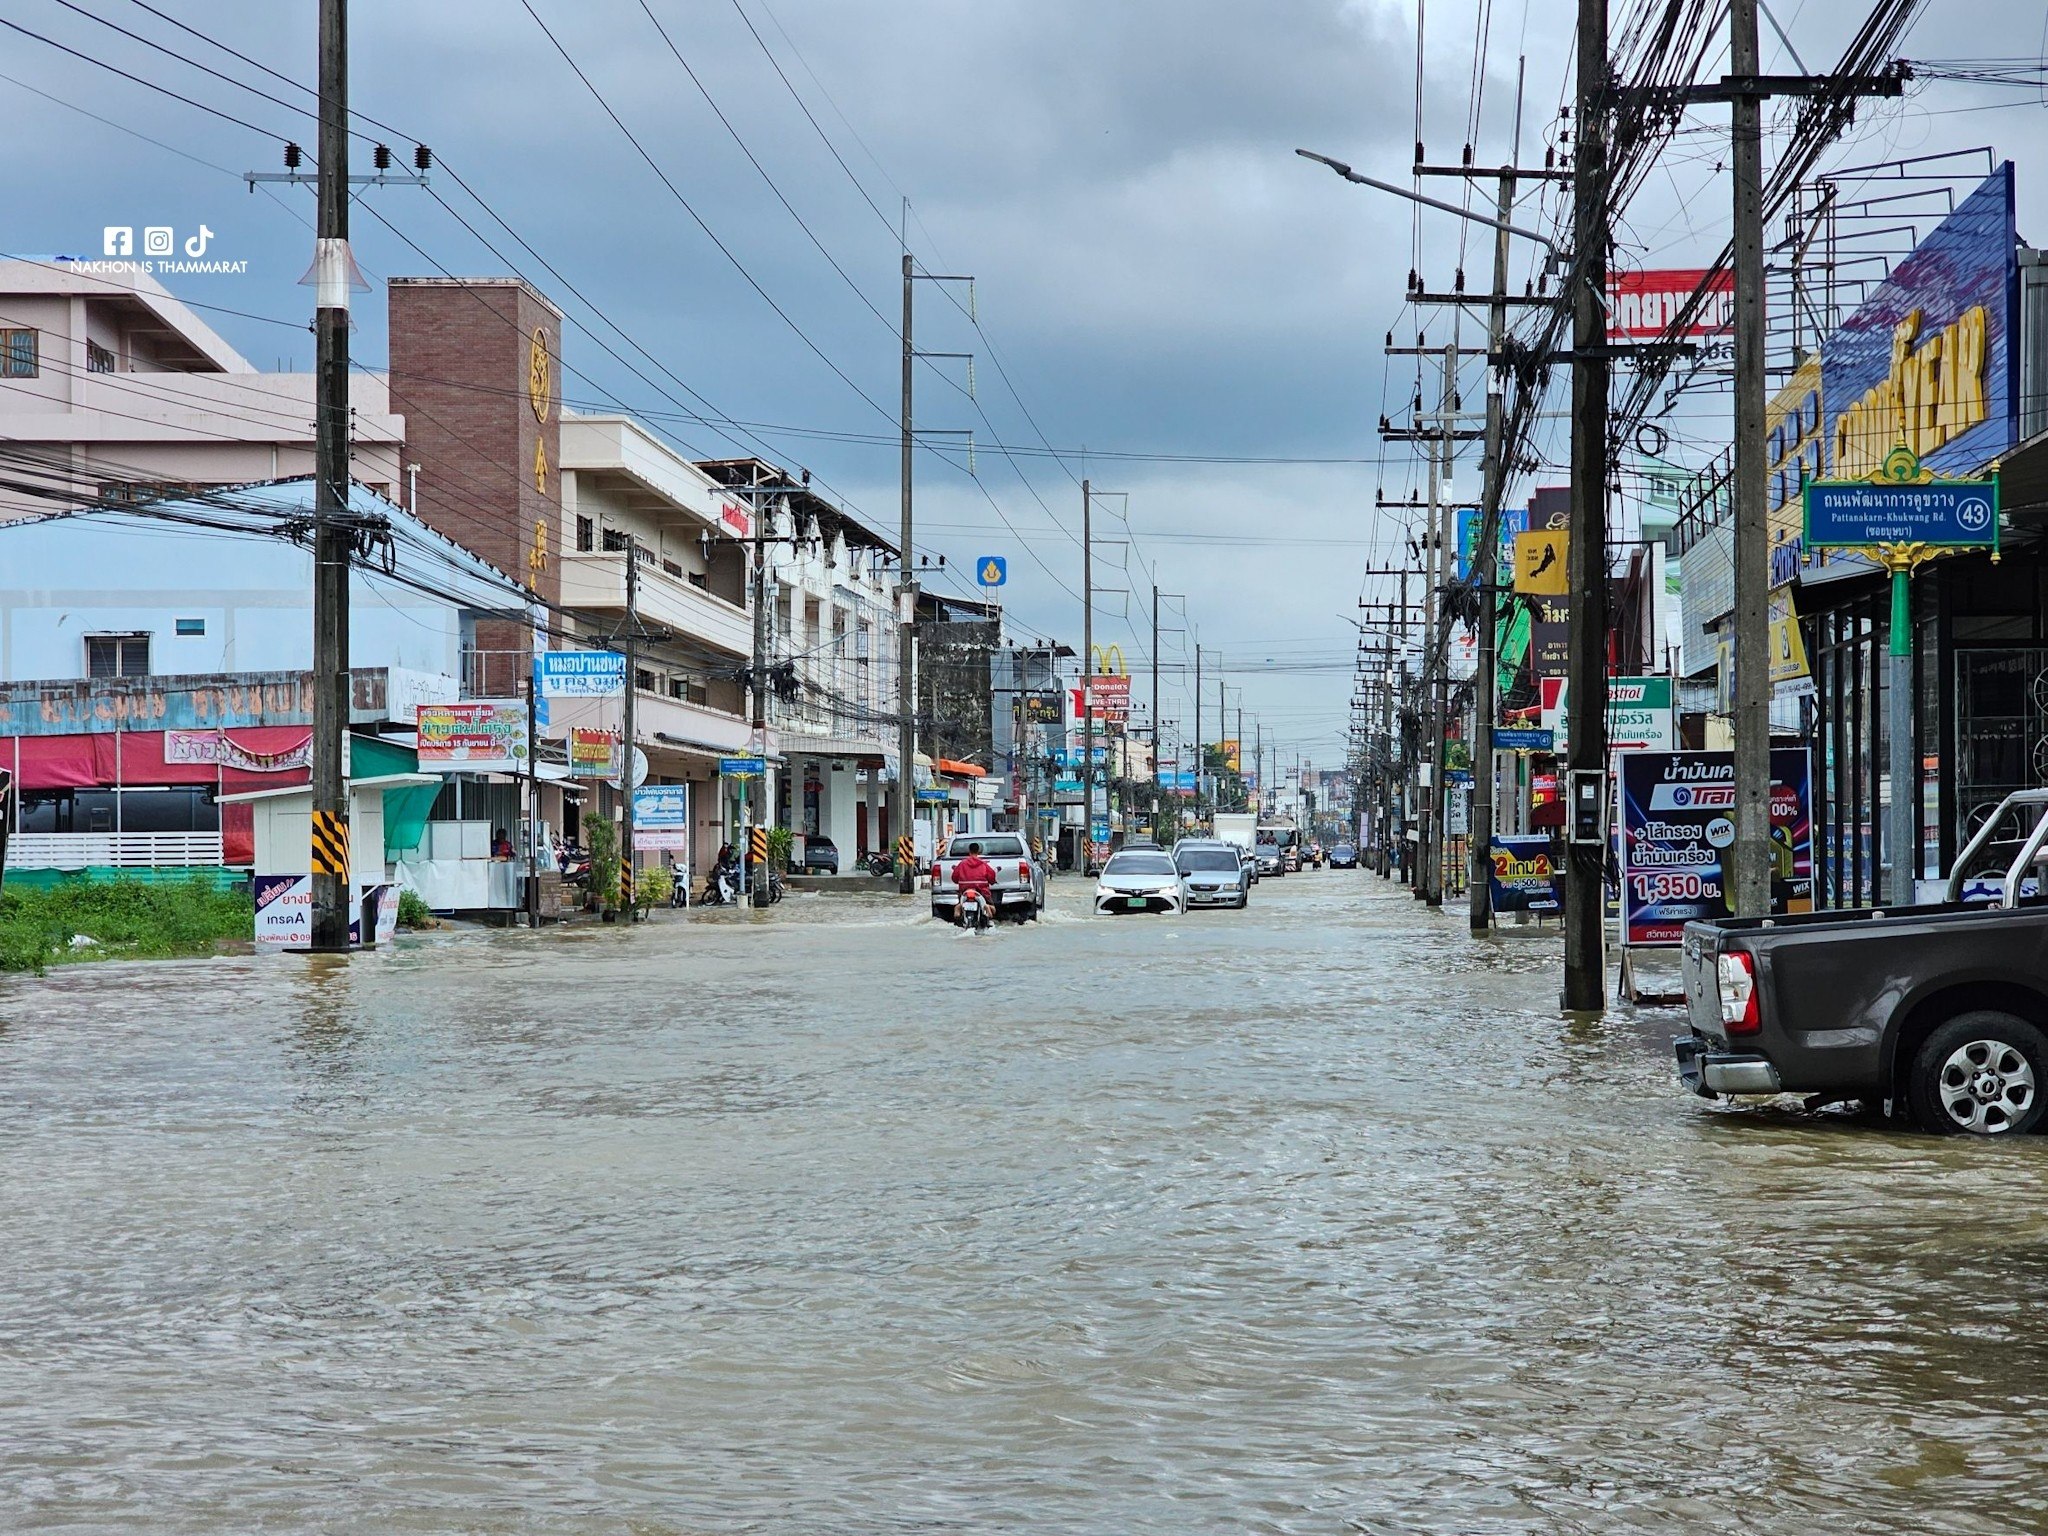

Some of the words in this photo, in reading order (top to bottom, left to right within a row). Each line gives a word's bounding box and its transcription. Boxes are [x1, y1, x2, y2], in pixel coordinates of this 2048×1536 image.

[1824, 490, 1955, 512] ถนนพัฒนาการคูขวาง
[1962, 504, 1985, 524] 43
[1831, 513, 1930, 523] Pattanakarn-Khukwang
[1933, 513, 1947, 522] Rd.
[1608, 686, 1641, 699] astrol
[1664, 757, 1735, 780] น้ำมันเค
[1691, 787, 1735, 804] Tran
[1771, 803, 1798, 817] 00%
[1648, 822, 1702, 841] ไส้กรอง
[1710, 824, 1731, 837] WIX
[1632, 842, 1716, 866] น้ำมันเครื่อง
[1635, 874, 1701, 903] 1,350
[1792, 881, 1810, 894] WIX
